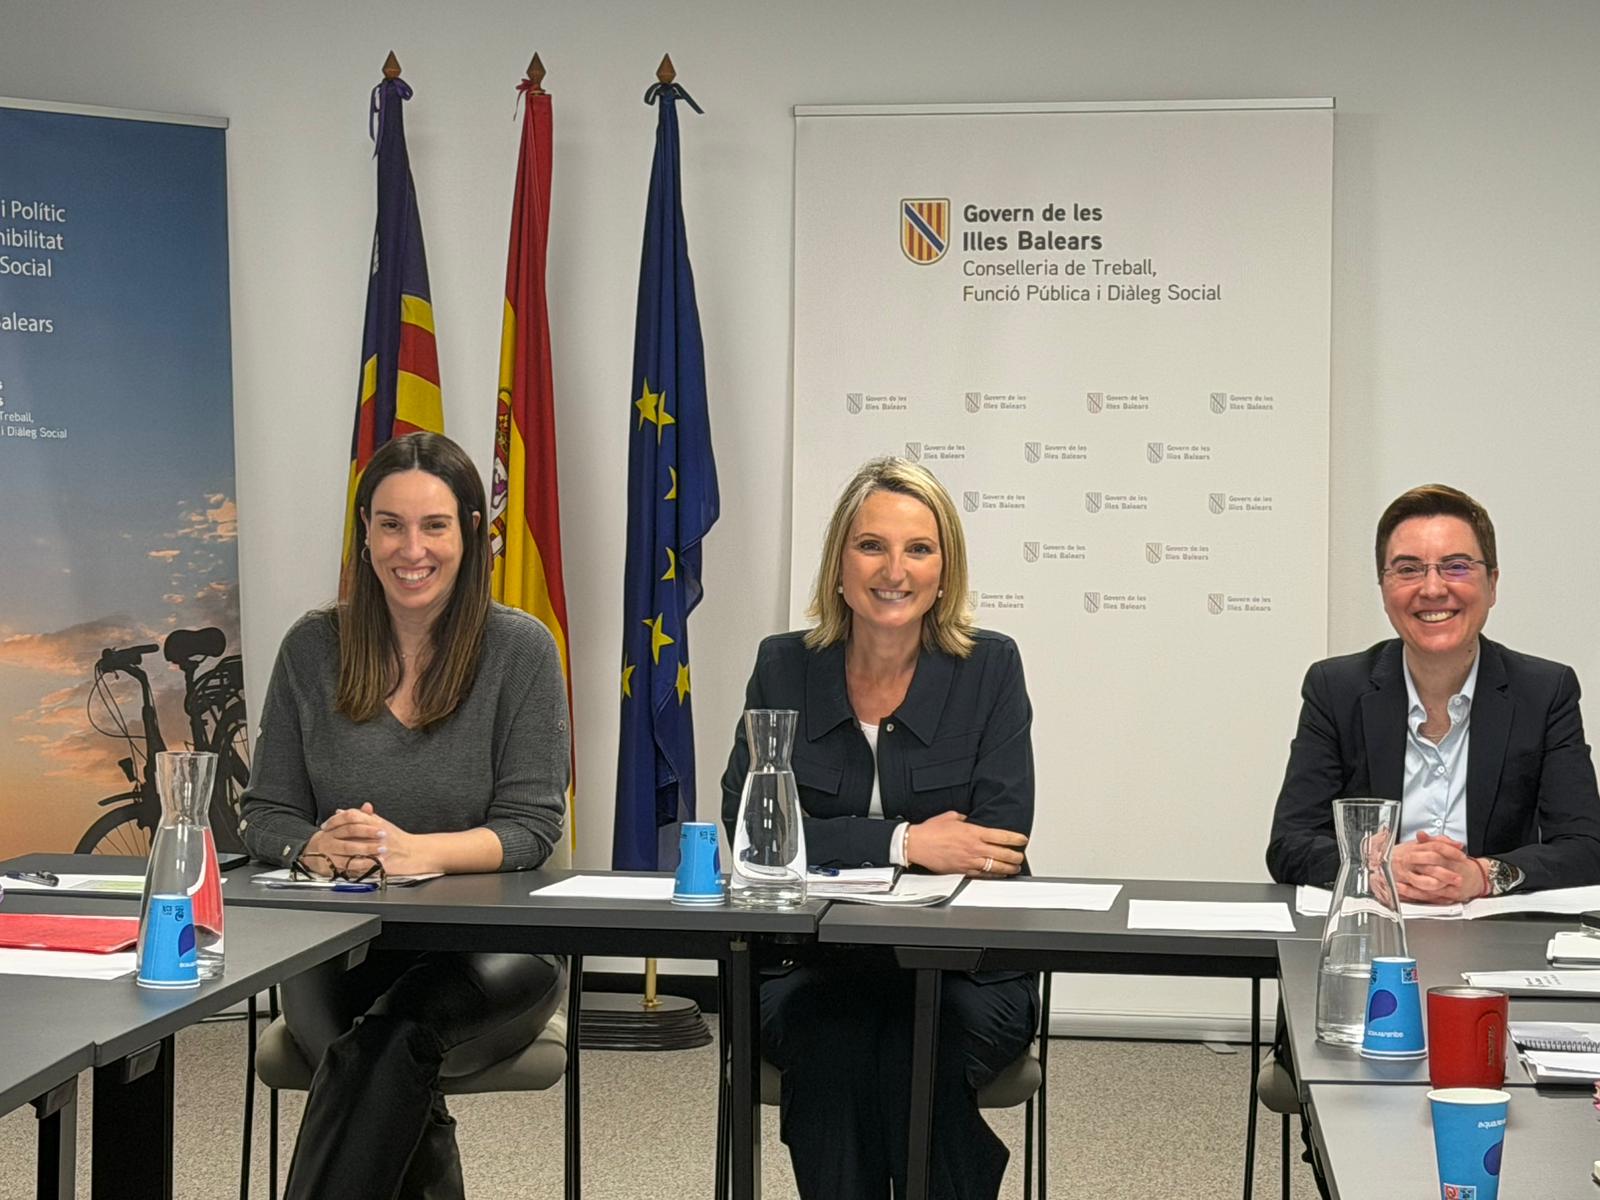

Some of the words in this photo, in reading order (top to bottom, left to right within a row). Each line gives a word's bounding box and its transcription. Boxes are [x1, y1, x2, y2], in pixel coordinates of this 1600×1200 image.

[1, 200, 6, 218] i
[11, 200, 66, 222] Polític
[963, 204, 1034, 223] Govern
[1041, 204, 1067, 222] de
[1073, 203, 1103, 222] les
[963, 232, 1008, 251] Illes
[1018, 231, 1103, 251] Balears
[0, 256, 52, 278] Social
[963, 259, 1059, 277] Conselleria
[1064, 259, 1087, 276] de
[1091, 258, 1158, 278] Treball,
[963, 284, 1020, 302] Funció
[1027, 284, 1091, 302] Pública
[1107, 284, 1161, 305] Diàleg
[1167, 283, 1222, 301] Social
[0, 312, 54, 333] alears
[40, 427, 68, 439] Social
